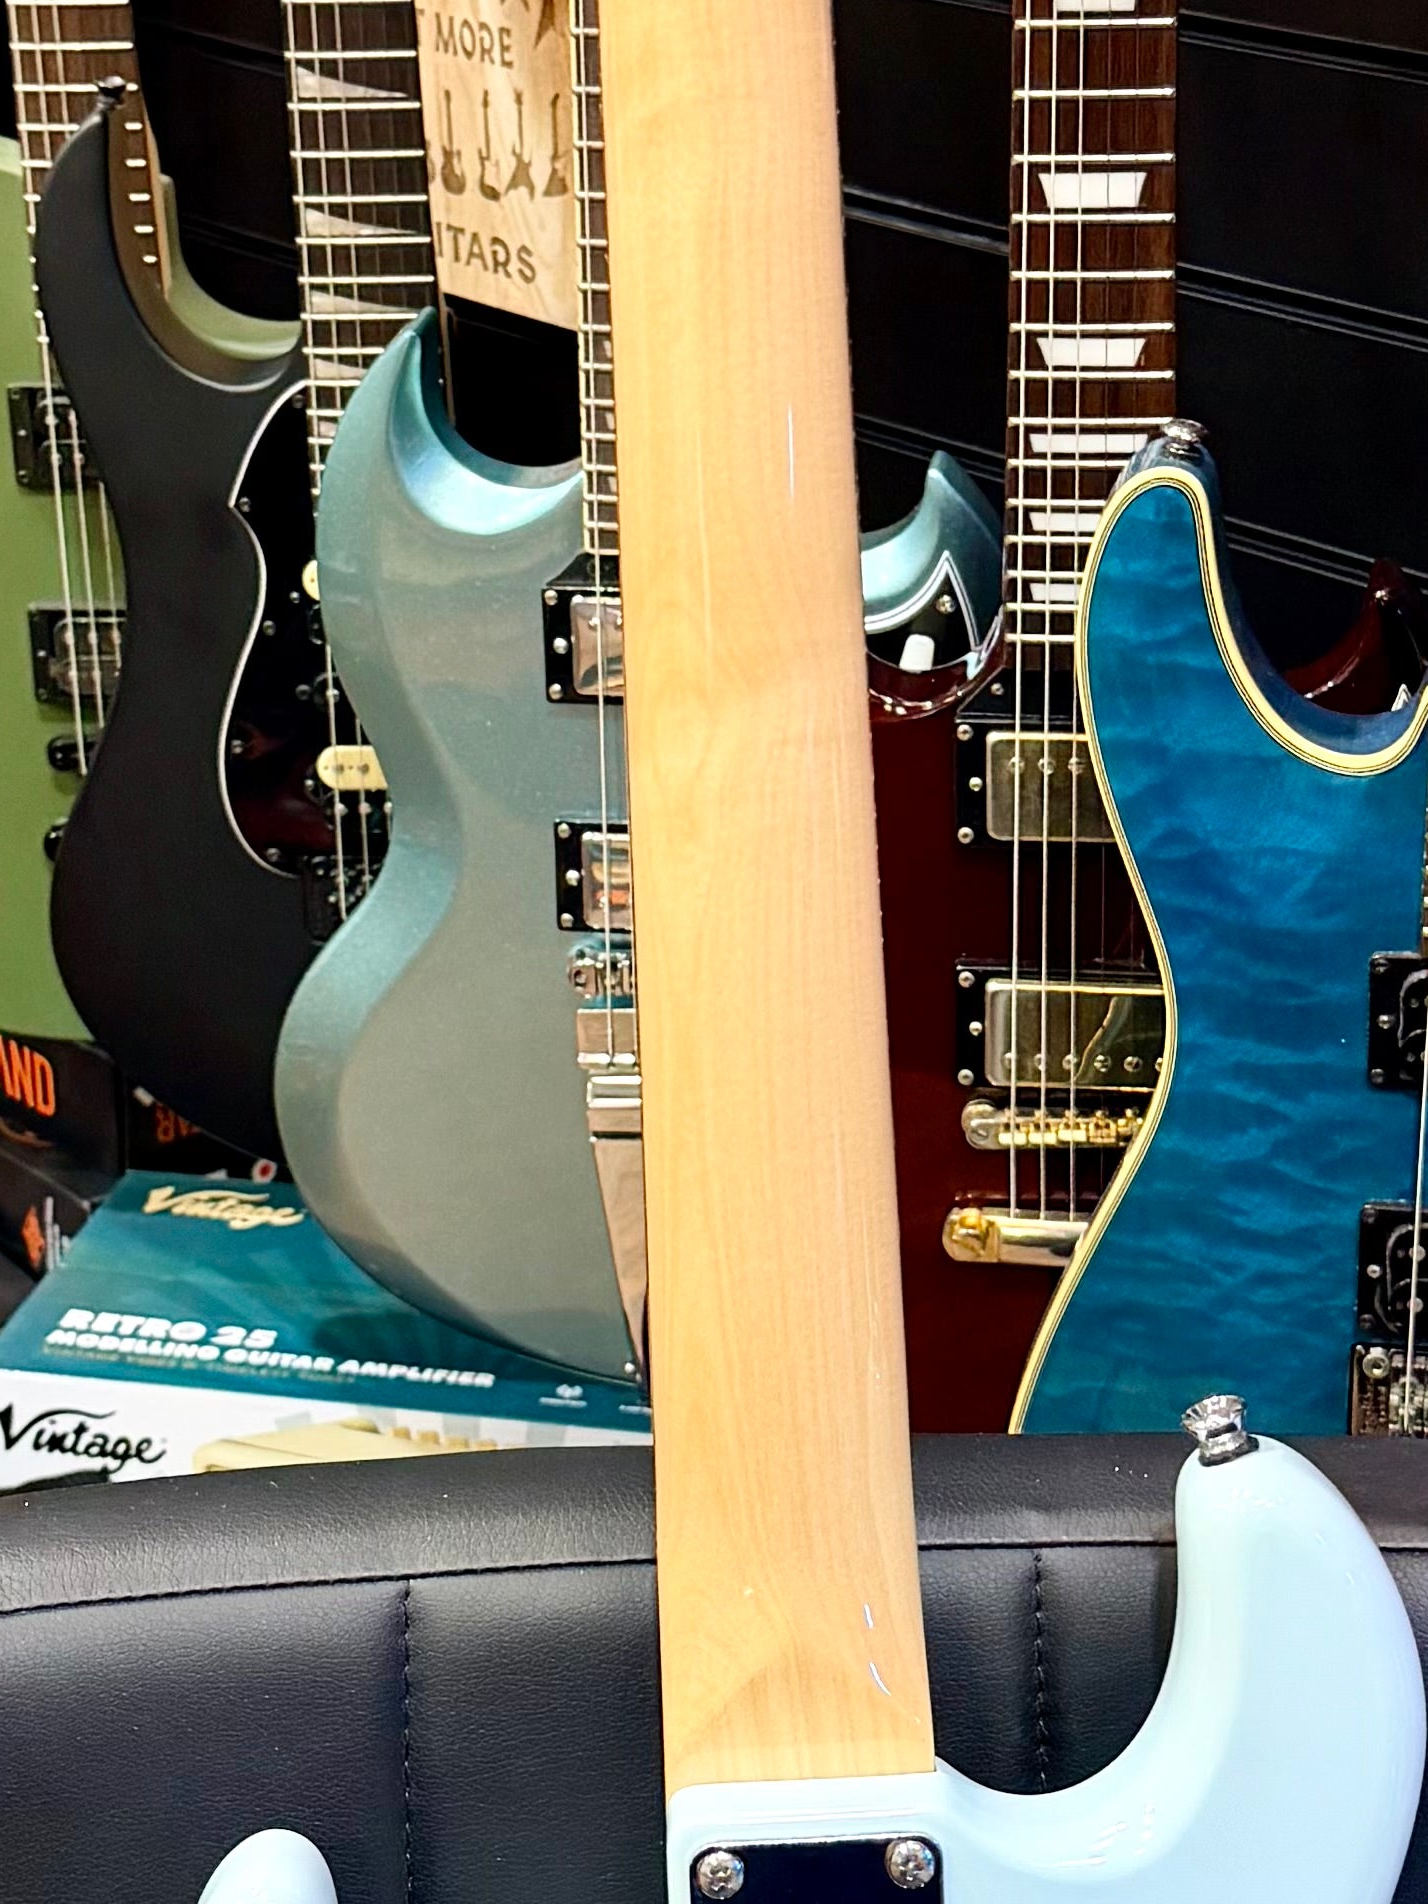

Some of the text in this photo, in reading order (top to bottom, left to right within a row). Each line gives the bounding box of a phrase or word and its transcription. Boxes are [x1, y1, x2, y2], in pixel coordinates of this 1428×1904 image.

[434, 15, 514, 69] MORE
[143, 1185, 305, 1230] Vintage
[60, 1307, 278, 1349] RETRO 25
[45, 1328, 218, 1362] MODELLING
[223, 1346, 333, 1374] GUITAR
[339, 1358, 495, 1389] AMPLIFIER
